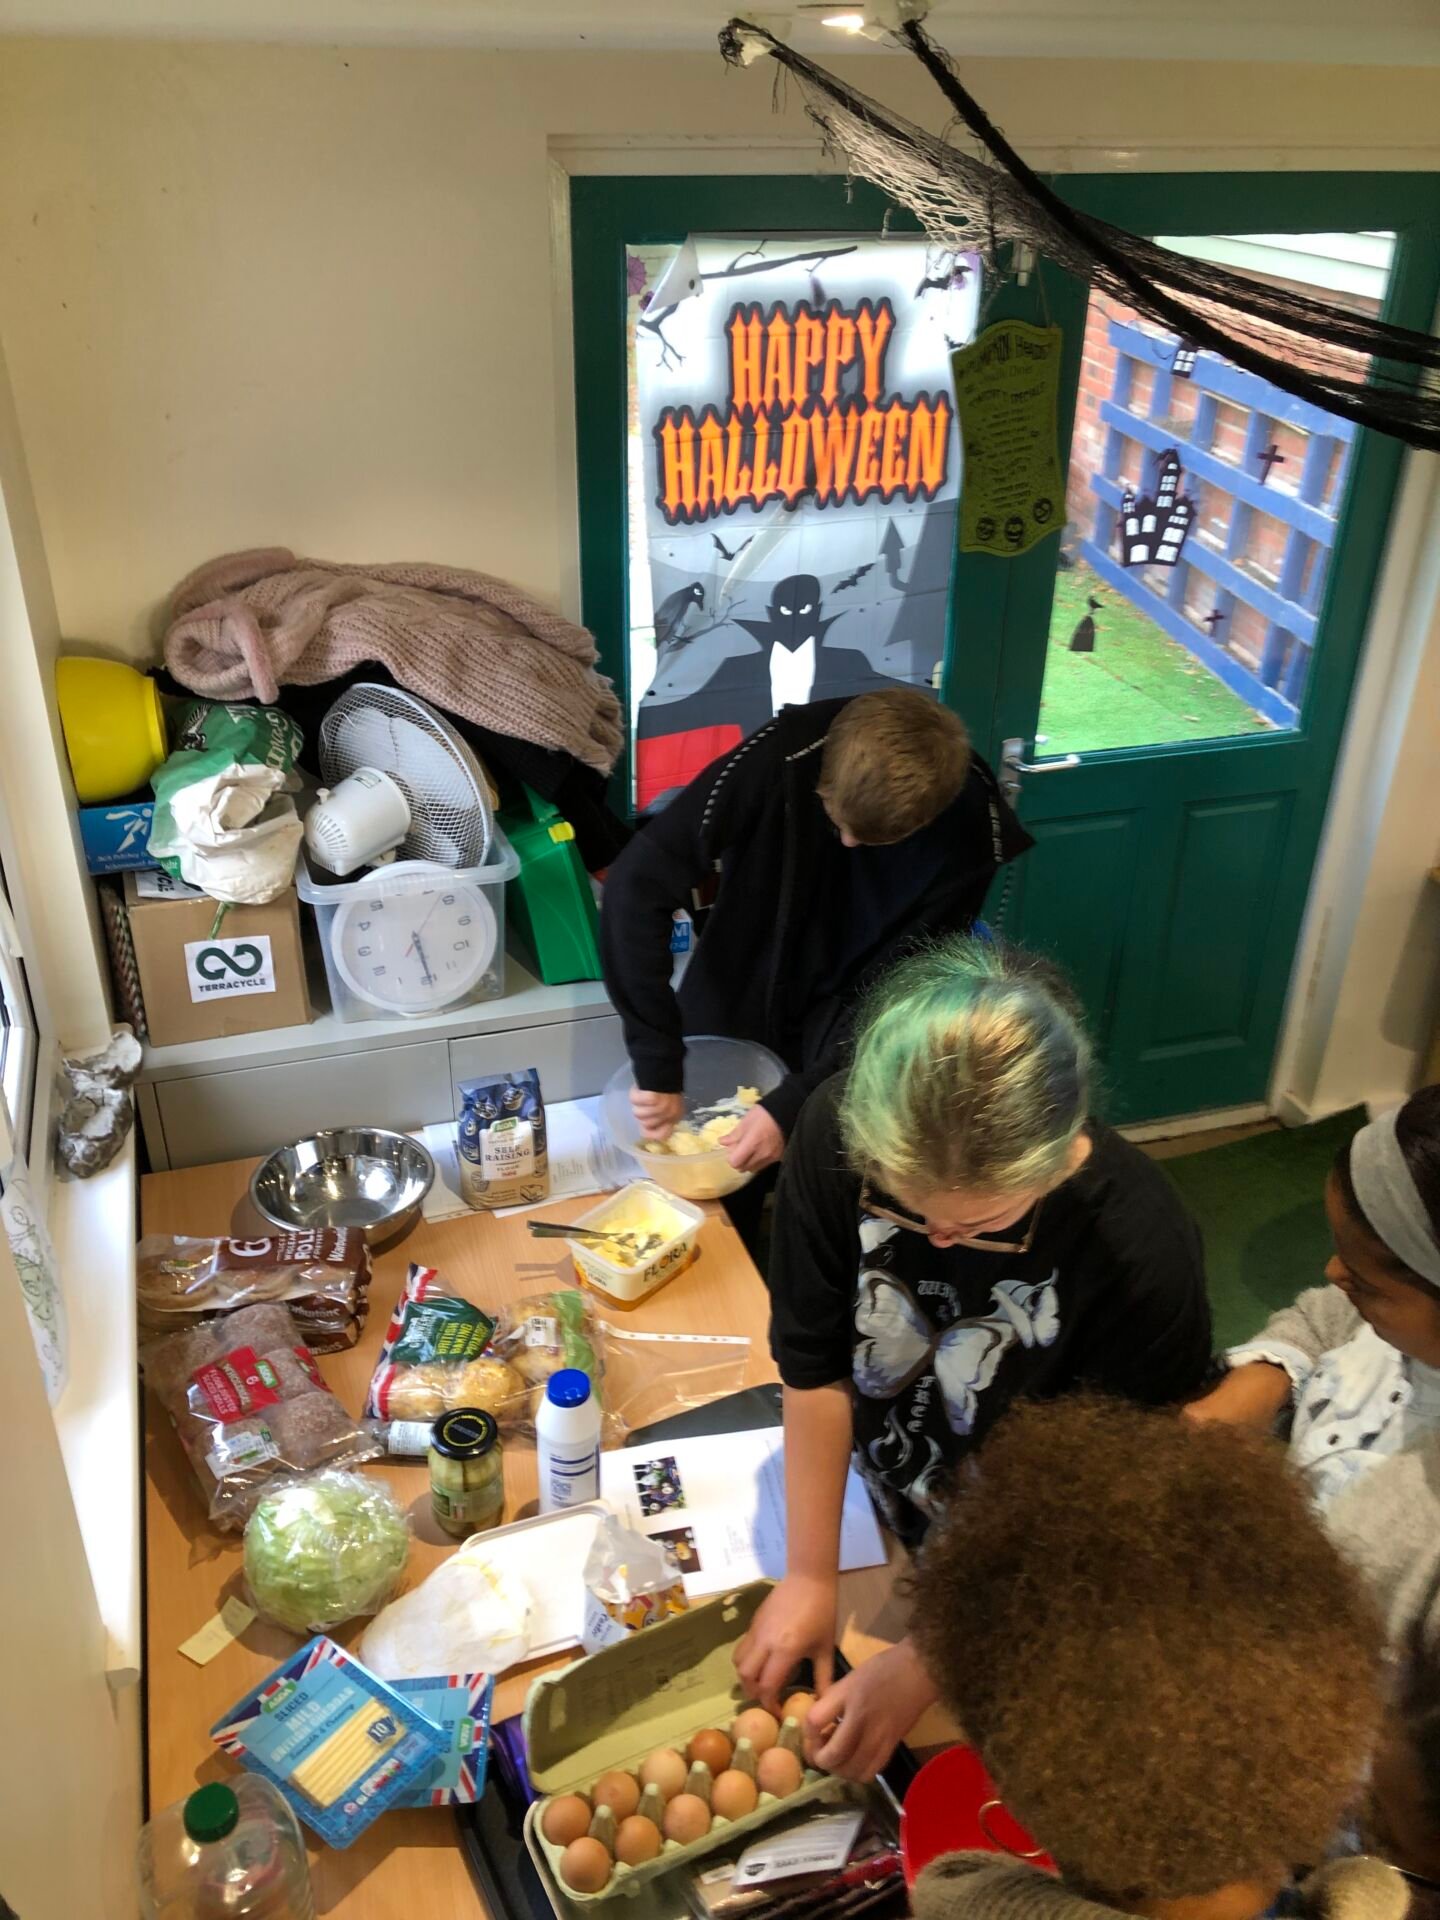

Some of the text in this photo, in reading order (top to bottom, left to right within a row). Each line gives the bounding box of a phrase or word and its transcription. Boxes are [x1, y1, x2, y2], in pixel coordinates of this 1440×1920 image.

[727, 300, 895, 416] HAPPY
[656, 394, 952, 523] HALLOWEEN
[198, 978, 267, 992] TERRACYCLE
[485, 1149, 529, 1162] RAISING
[494, 1145, 521, 1154] SELF
[294, 1229, 314, 1259] ROLL
[643, 1242, 687, 1282] FLORA
[437, 1322, 459, 1354] BRITISH
[449, 1323, 472, 1354] BAKING
[246, 1375, 259, 1385] 6
[268, 1688, 292, 1709] ASDA
[274, 1691, 309, 1722] SLICED
[285, 1701, 321, 1733] MILD
[370, 1721, 389, 1737] 10
[459, 1723, 470, 1748] ASDA
